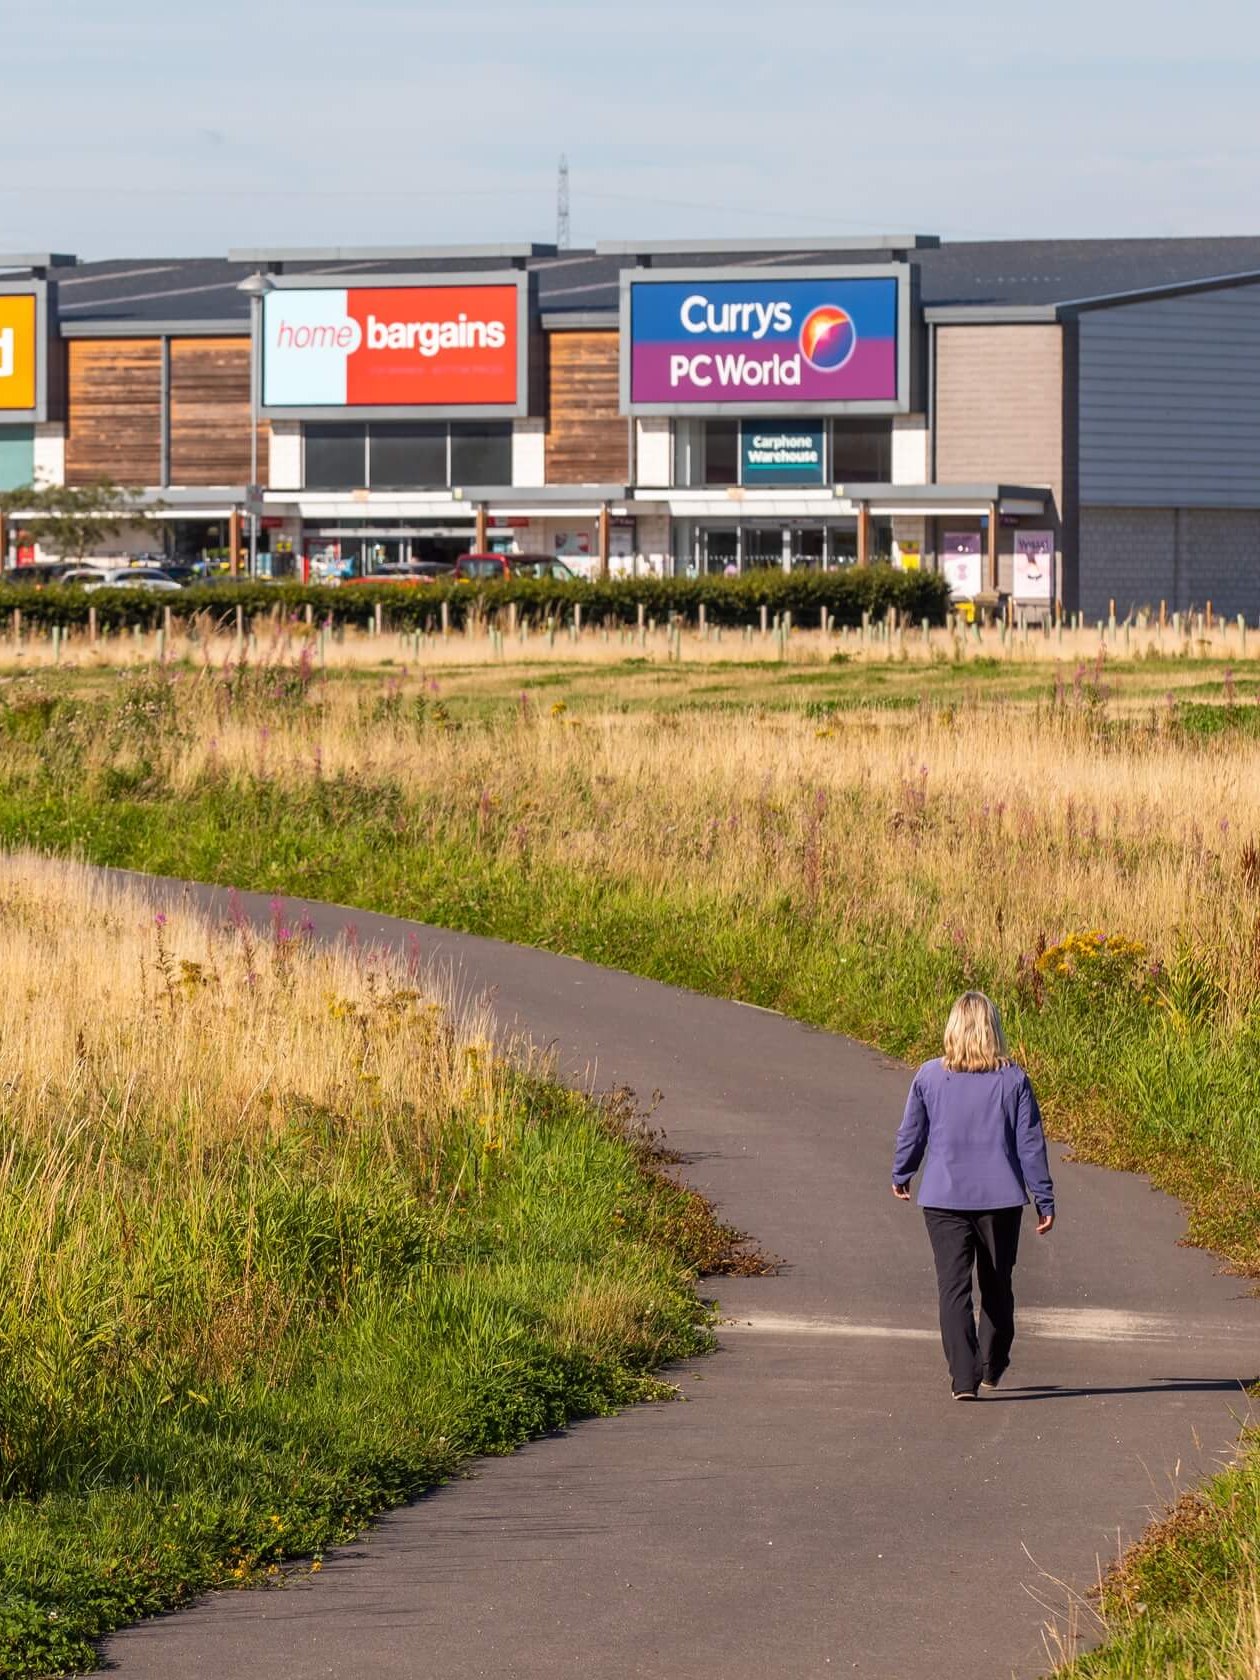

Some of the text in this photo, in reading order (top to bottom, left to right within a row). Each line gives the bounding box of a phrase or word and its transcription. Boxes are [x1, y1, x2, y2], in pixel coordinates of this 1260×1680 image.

[680, 295, 793, 340] Currys
[277, 313, 506, 357] home bargains
[670, 353, 802, 387] PC World
[747, 449, 819, 464] Warehouse
[753, 434, 813, 450] Carphone
